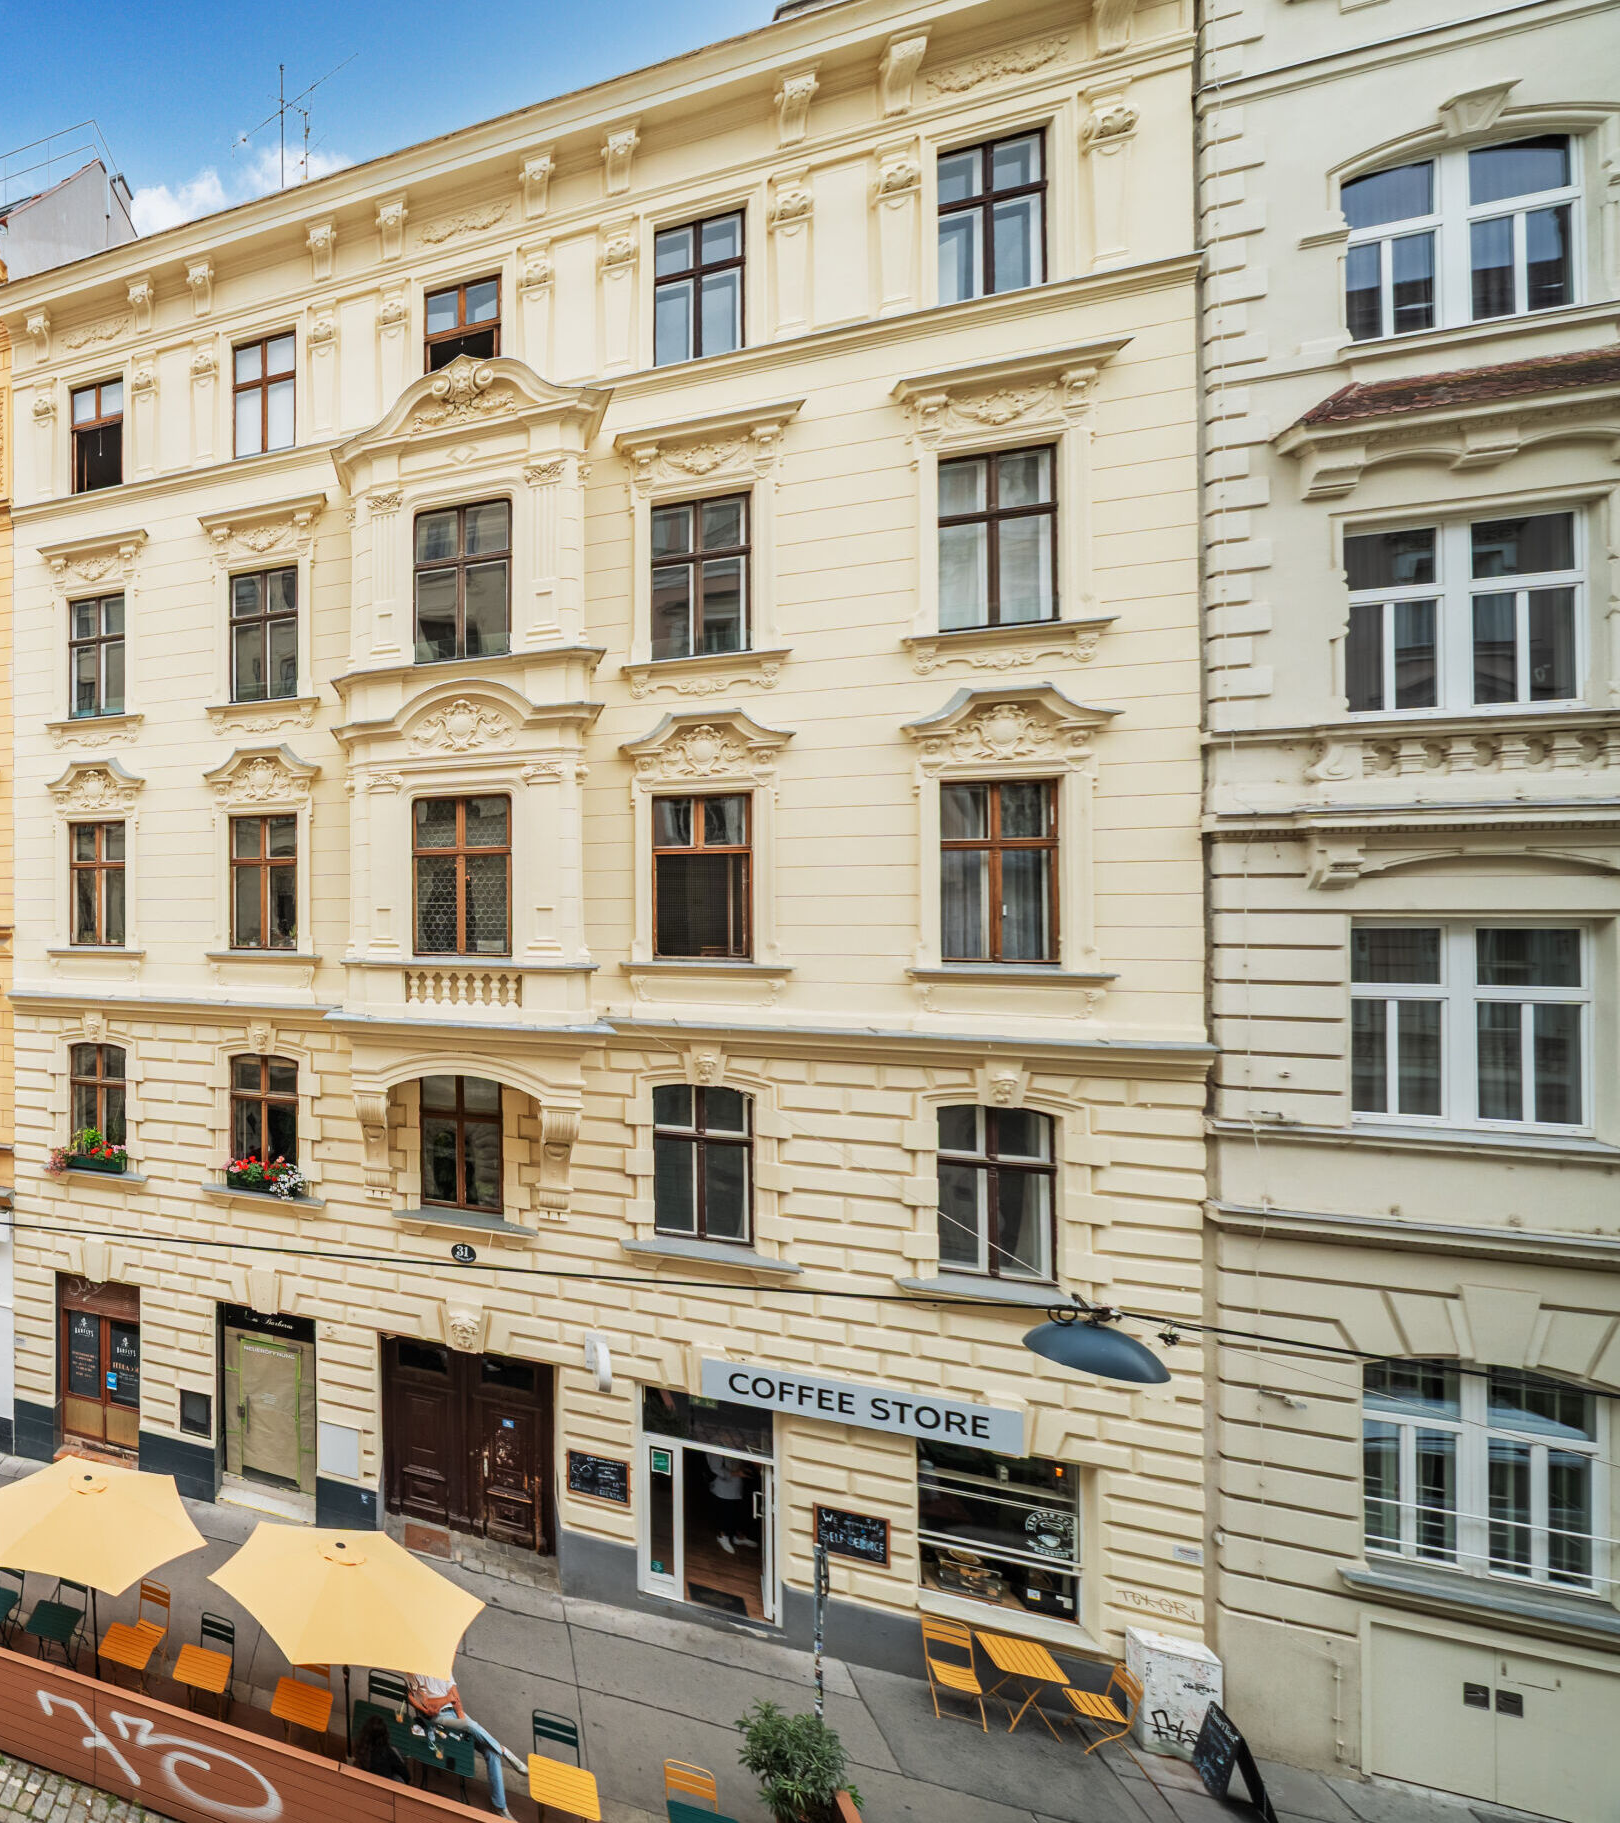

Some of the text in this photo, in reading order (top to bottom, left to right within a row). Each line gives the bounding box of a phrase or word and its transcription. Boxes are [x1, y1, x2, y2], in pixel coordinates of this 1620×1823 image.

[456, 1245, 469, 1258] 31
[728, 1372, 991, 1440] COFFEE STORE
